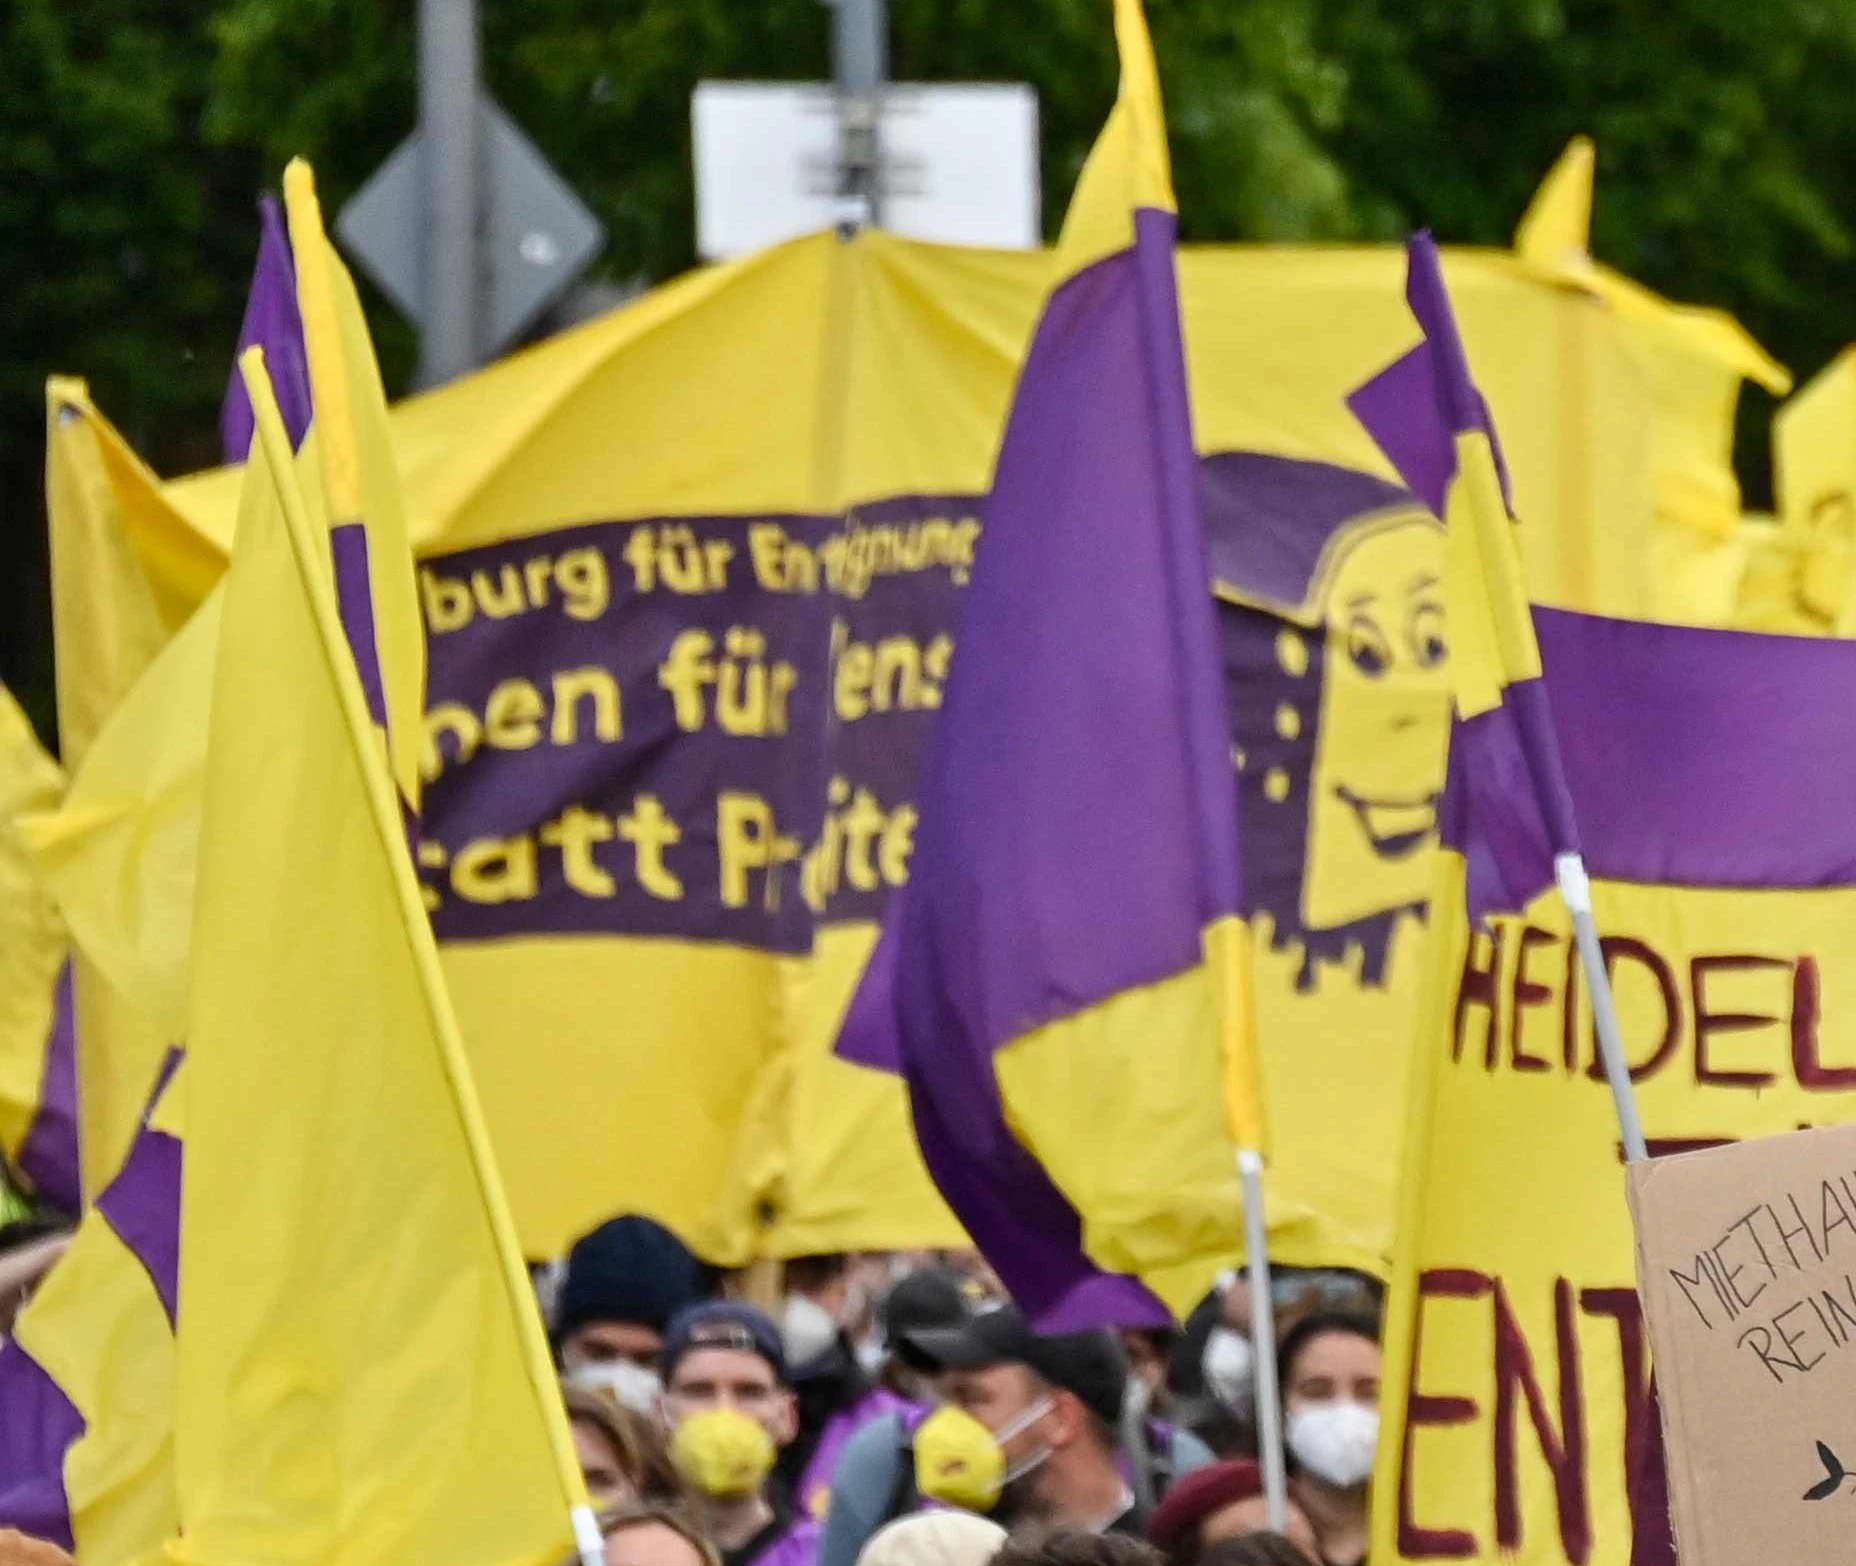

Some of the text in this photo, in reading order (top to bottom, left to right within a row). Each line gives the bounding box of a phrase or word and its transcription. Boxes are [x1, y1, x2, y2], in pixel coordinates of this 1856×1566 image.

[420, 545, 611, 636] burg
[624, 522, 736, 597] für
[660, 626, 797, 737] für
